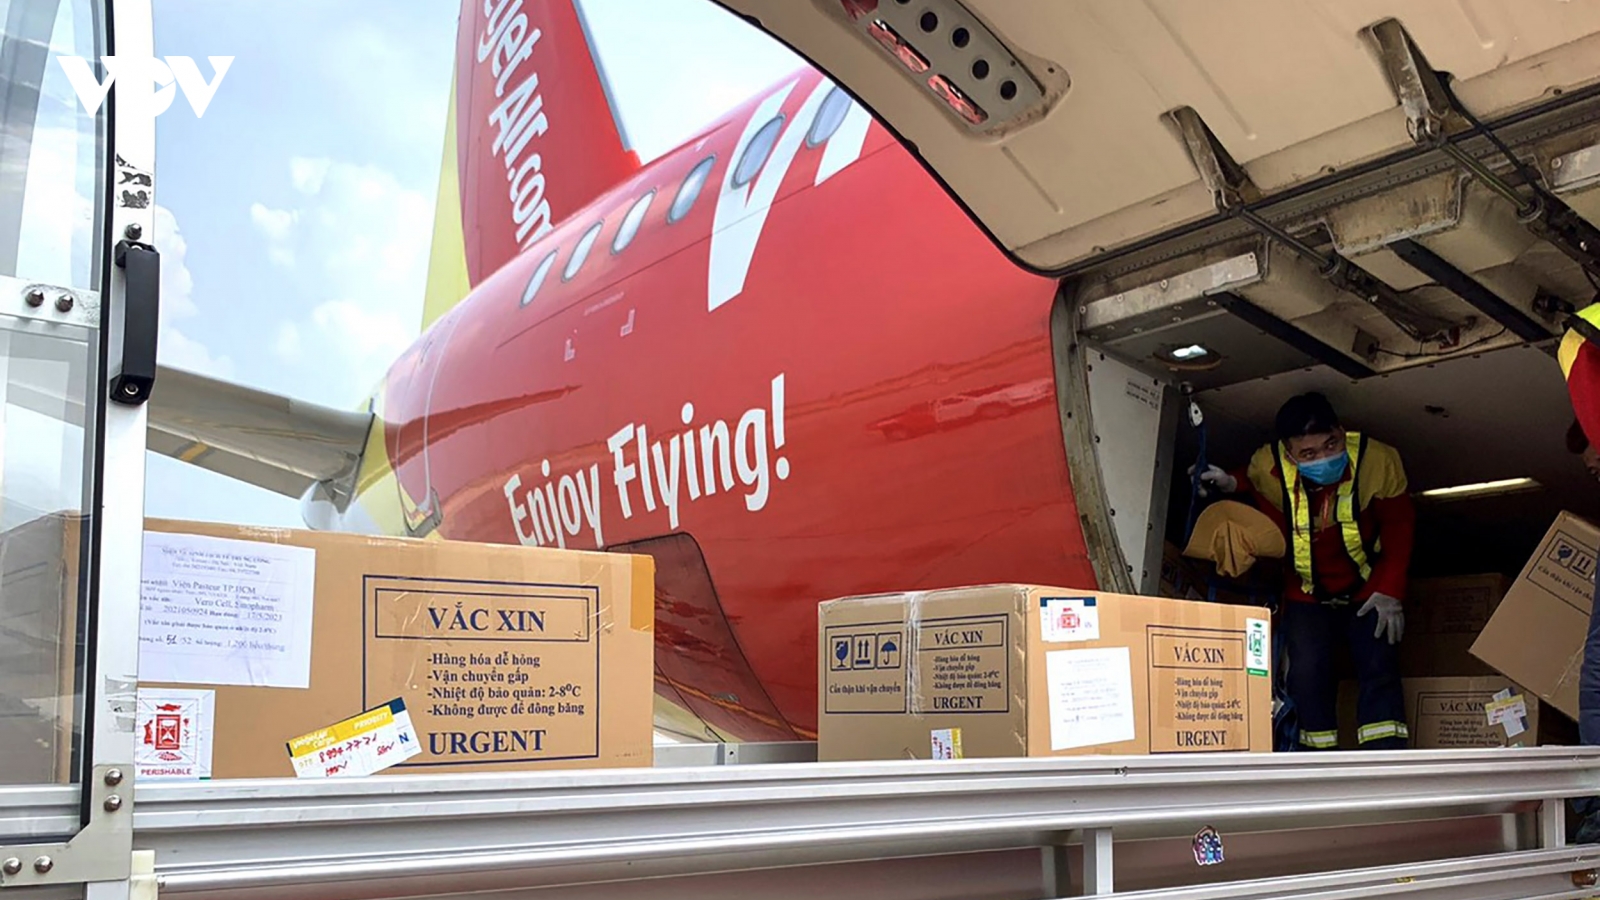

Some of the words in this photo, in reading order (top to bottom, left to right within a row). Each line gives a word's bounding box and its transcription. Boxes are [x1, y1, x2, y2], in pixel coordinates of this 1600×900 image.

[503, 459, 604, 549] Enjoy
[607, 372, 790, 531] Flying!
[428, 602, 489, 631] VẮC
[497, 610, 546, 632] XIN
[961, 630, 983, 644] XIN
[470, 653, 491, 666] hóa
[512, 653, 541, 668] hỏng
[1203, 648, 1225, 663] XIN
[461, 667, 504, 685] chuyển
[507, 667, 529, 685] gấp
[469, 687, 484, 701] độ
[487, 686, 509, 699] bảo
[933, 696, 983, 709] URGENT
[477, 704, 507, 718] được
[557, 703, 585, 716] băng
[399, 732, 410, 744] N
[428, 729, 547, 755] URGENT
[1176, 730, 1227, 747] URGENT
[140, 767, 192, 776] PERISHABLE
